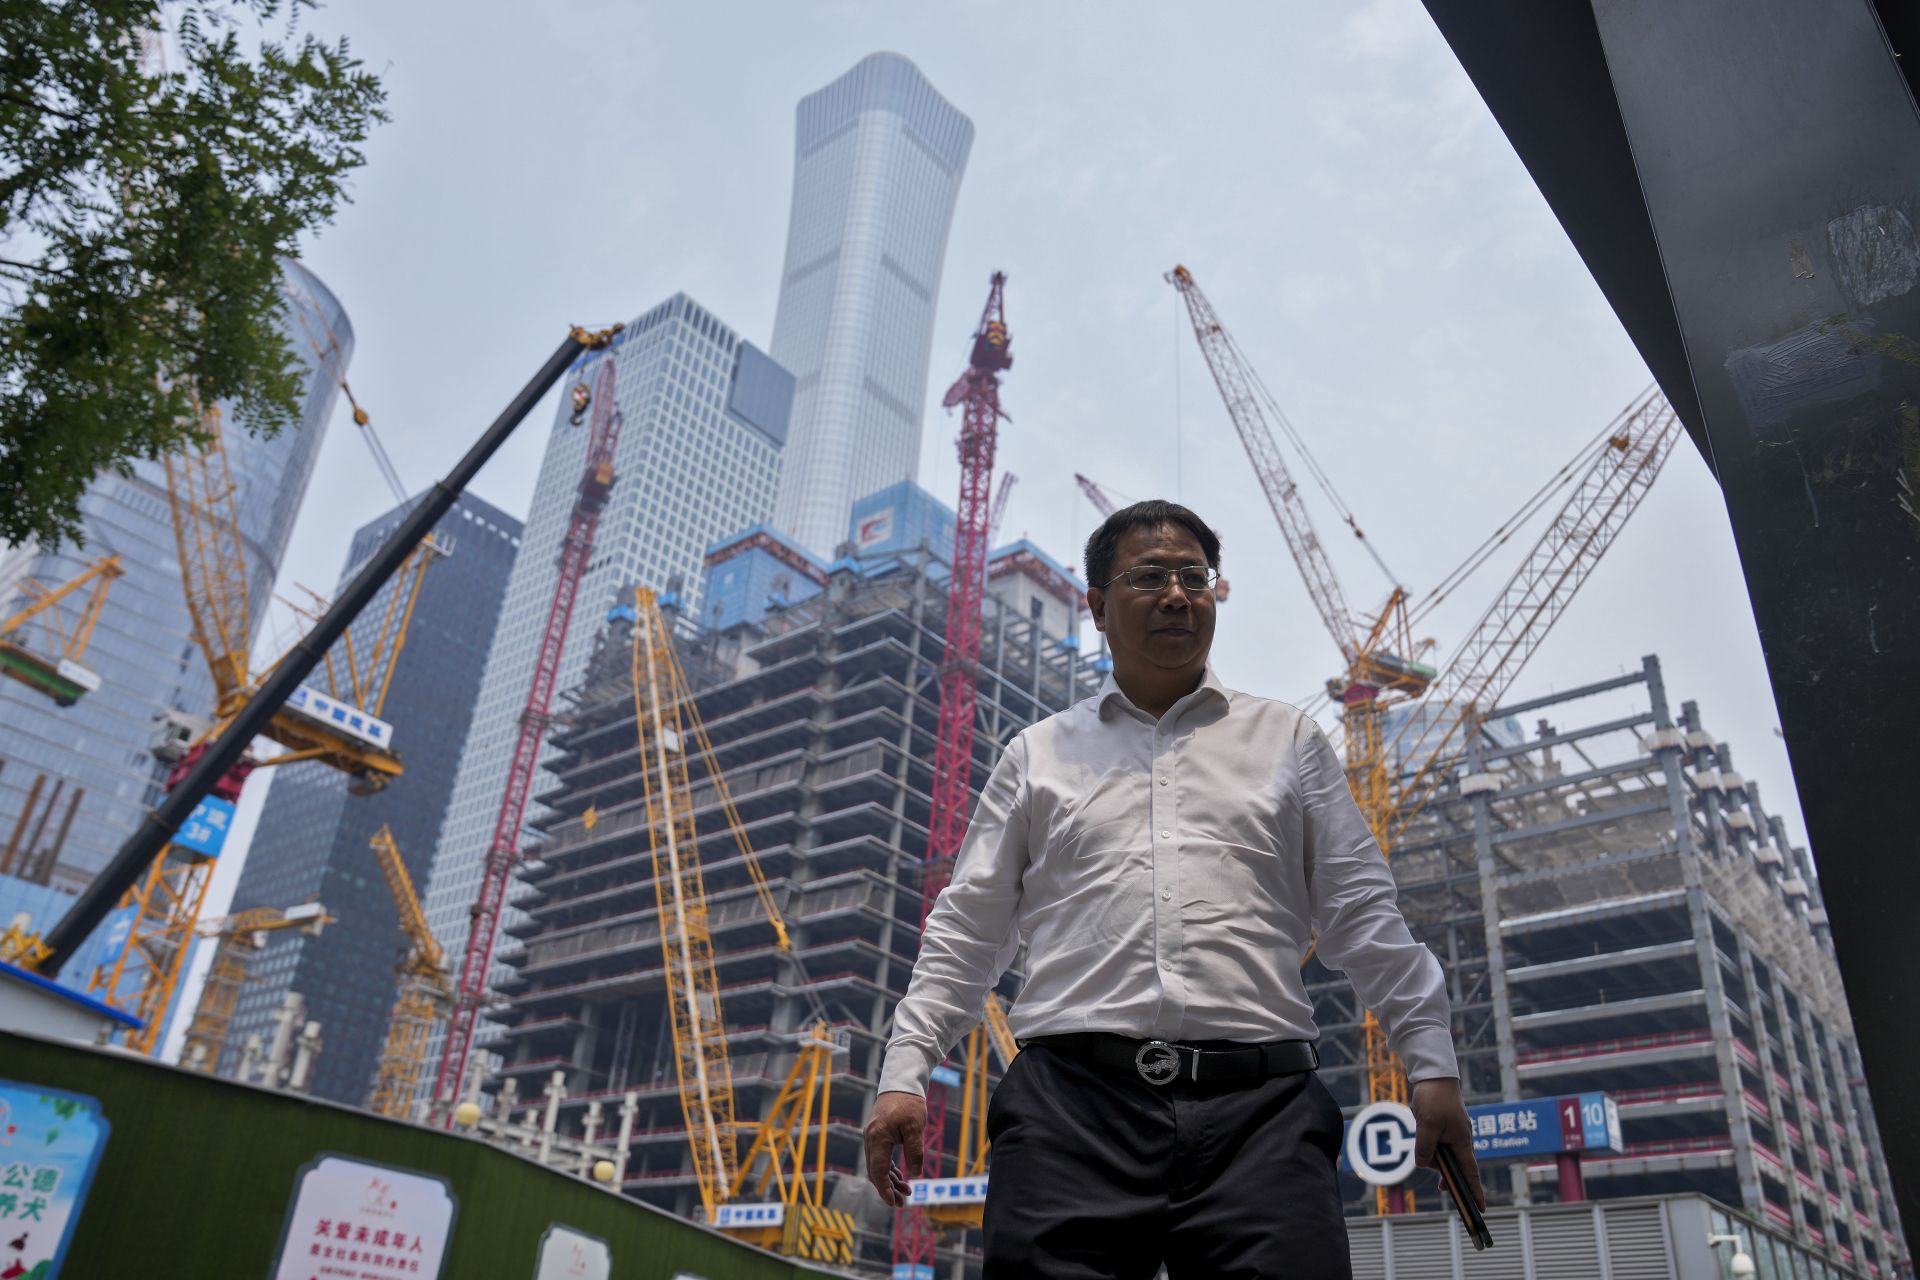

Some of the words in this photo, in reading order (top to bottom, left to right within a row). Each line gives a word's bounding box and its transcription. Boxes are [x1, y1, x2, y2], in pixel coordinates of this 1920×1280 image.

[1564, 1105, 1576, 1128] 1
[1583, 1103, 1604, 1126] 10
[1491, 1137, 1530, 1149] Station
[0, 1163, 59, 1193] 公德
